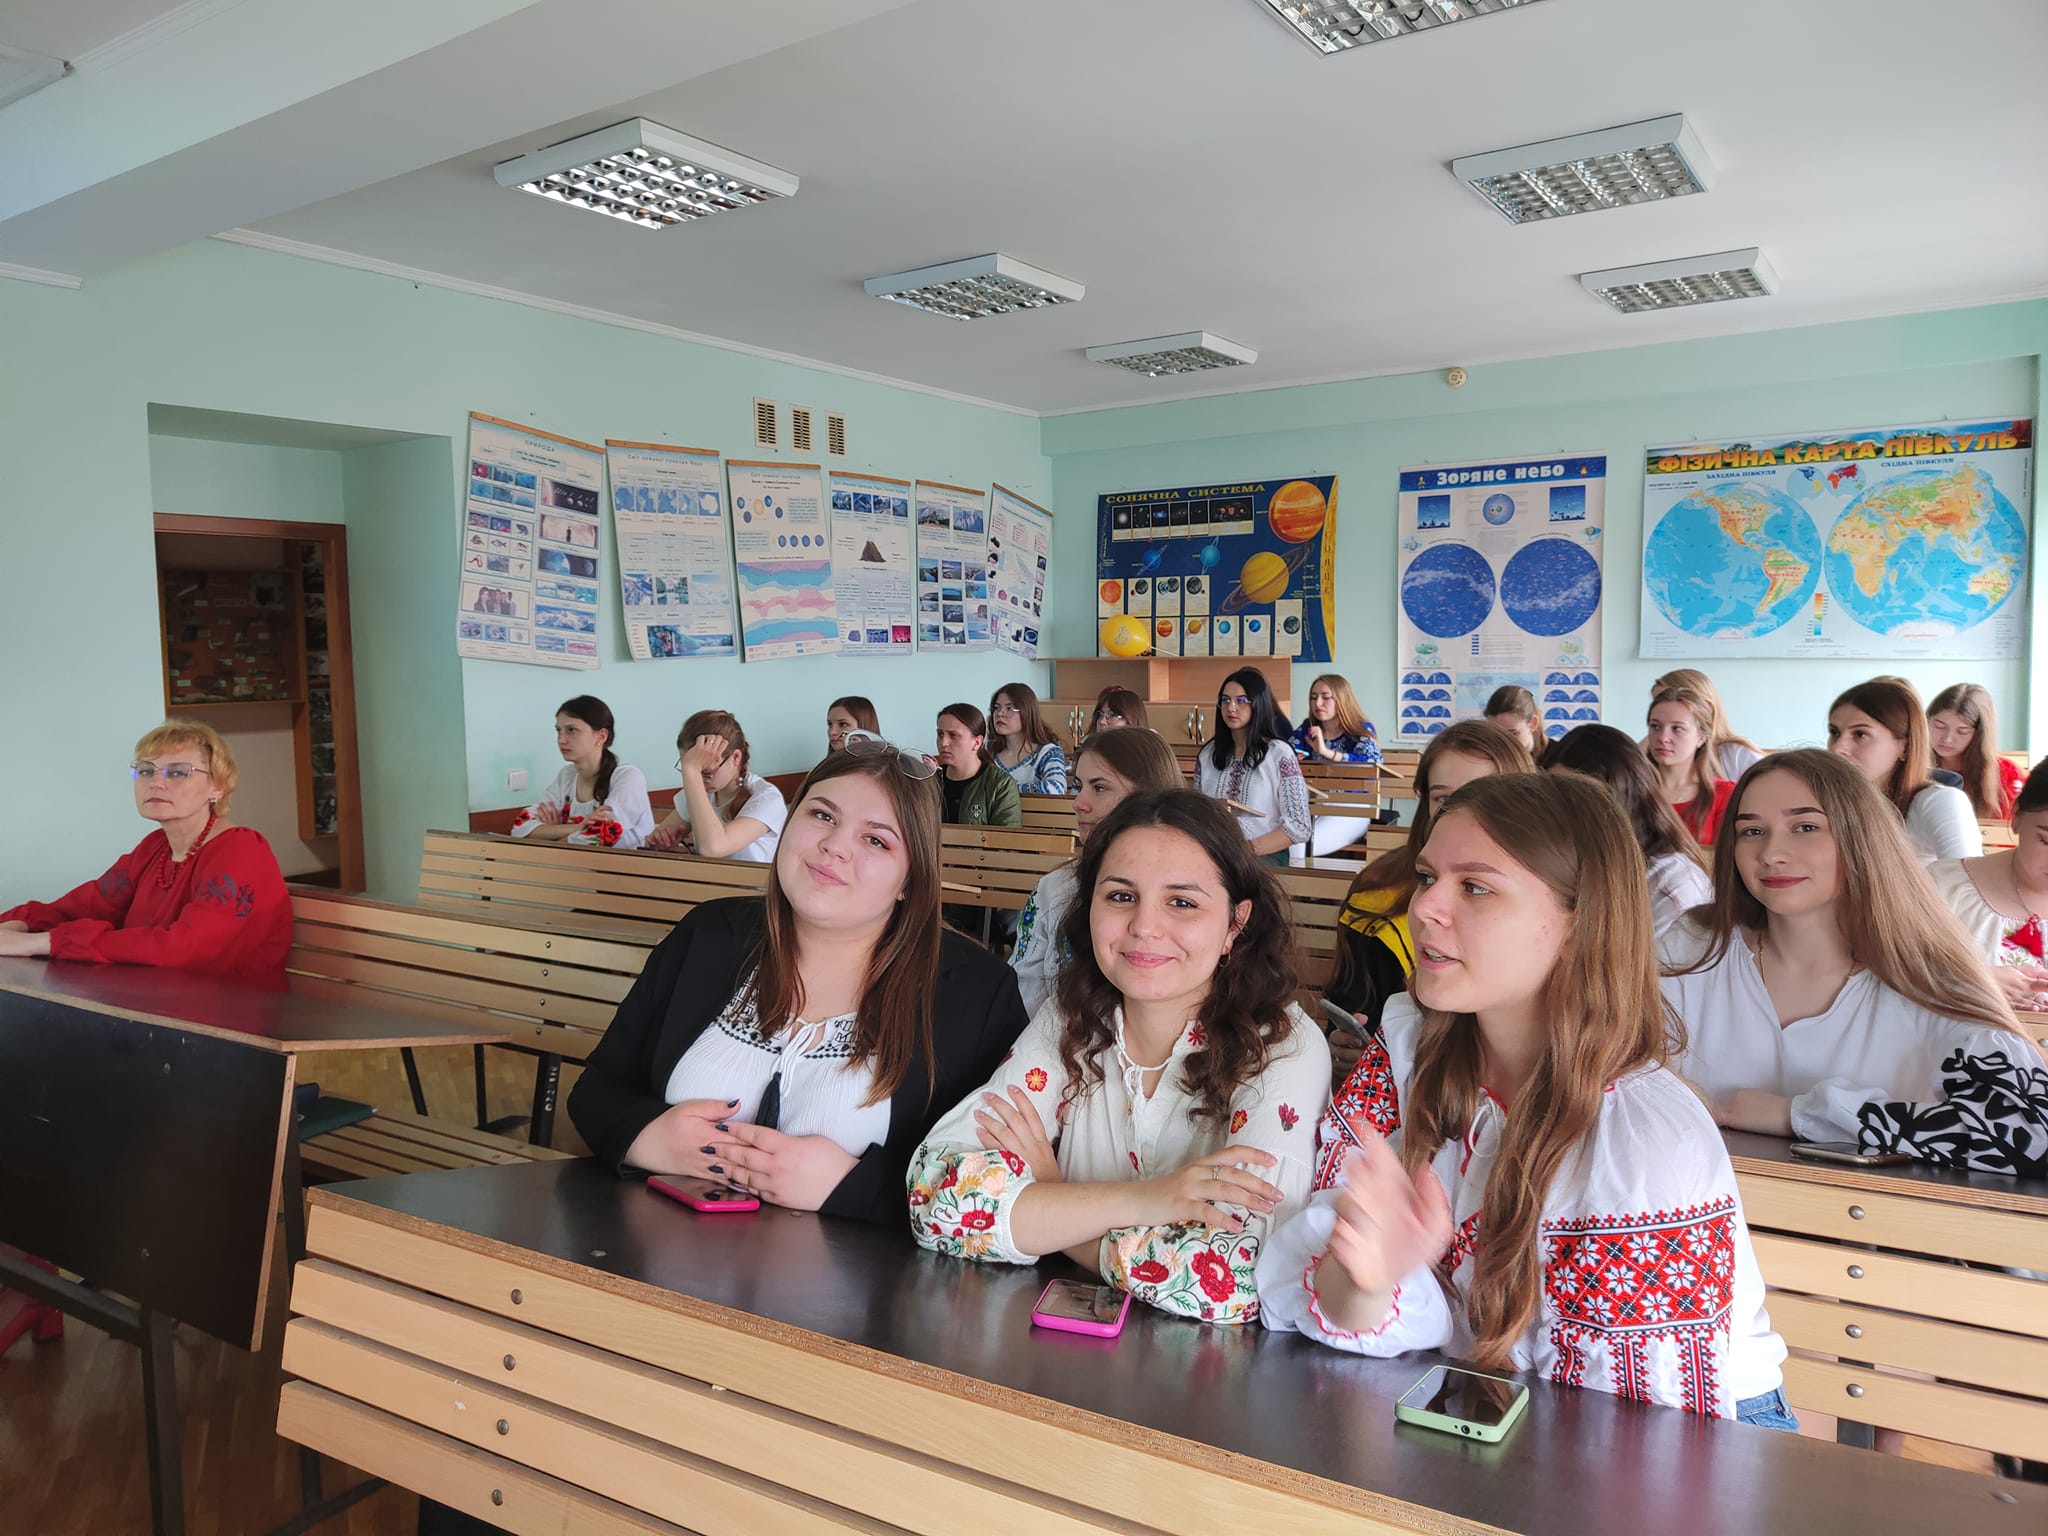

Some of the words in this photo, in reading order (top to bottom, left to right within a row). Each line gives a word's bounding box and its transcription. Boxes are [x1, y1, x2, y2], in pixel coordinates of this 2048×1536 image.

[1657, 449, 1777, 472] ФІЗИЧНА
[1784, 441, 1877, 465] КАРТА
[1884, 431, 2018, 458] ПІВКУЛЬ
[1880, 460, 1914, 468] СХІДНА
[1916, 457, 1954, 466] ПІВКУЛЯ
[1706, 471, 1741, 480] ЗАХІДНА
[1106, 490, 1181, 504] СОНЯЧНА
[1187, 483, 1265, 498] СИСТЕМА
